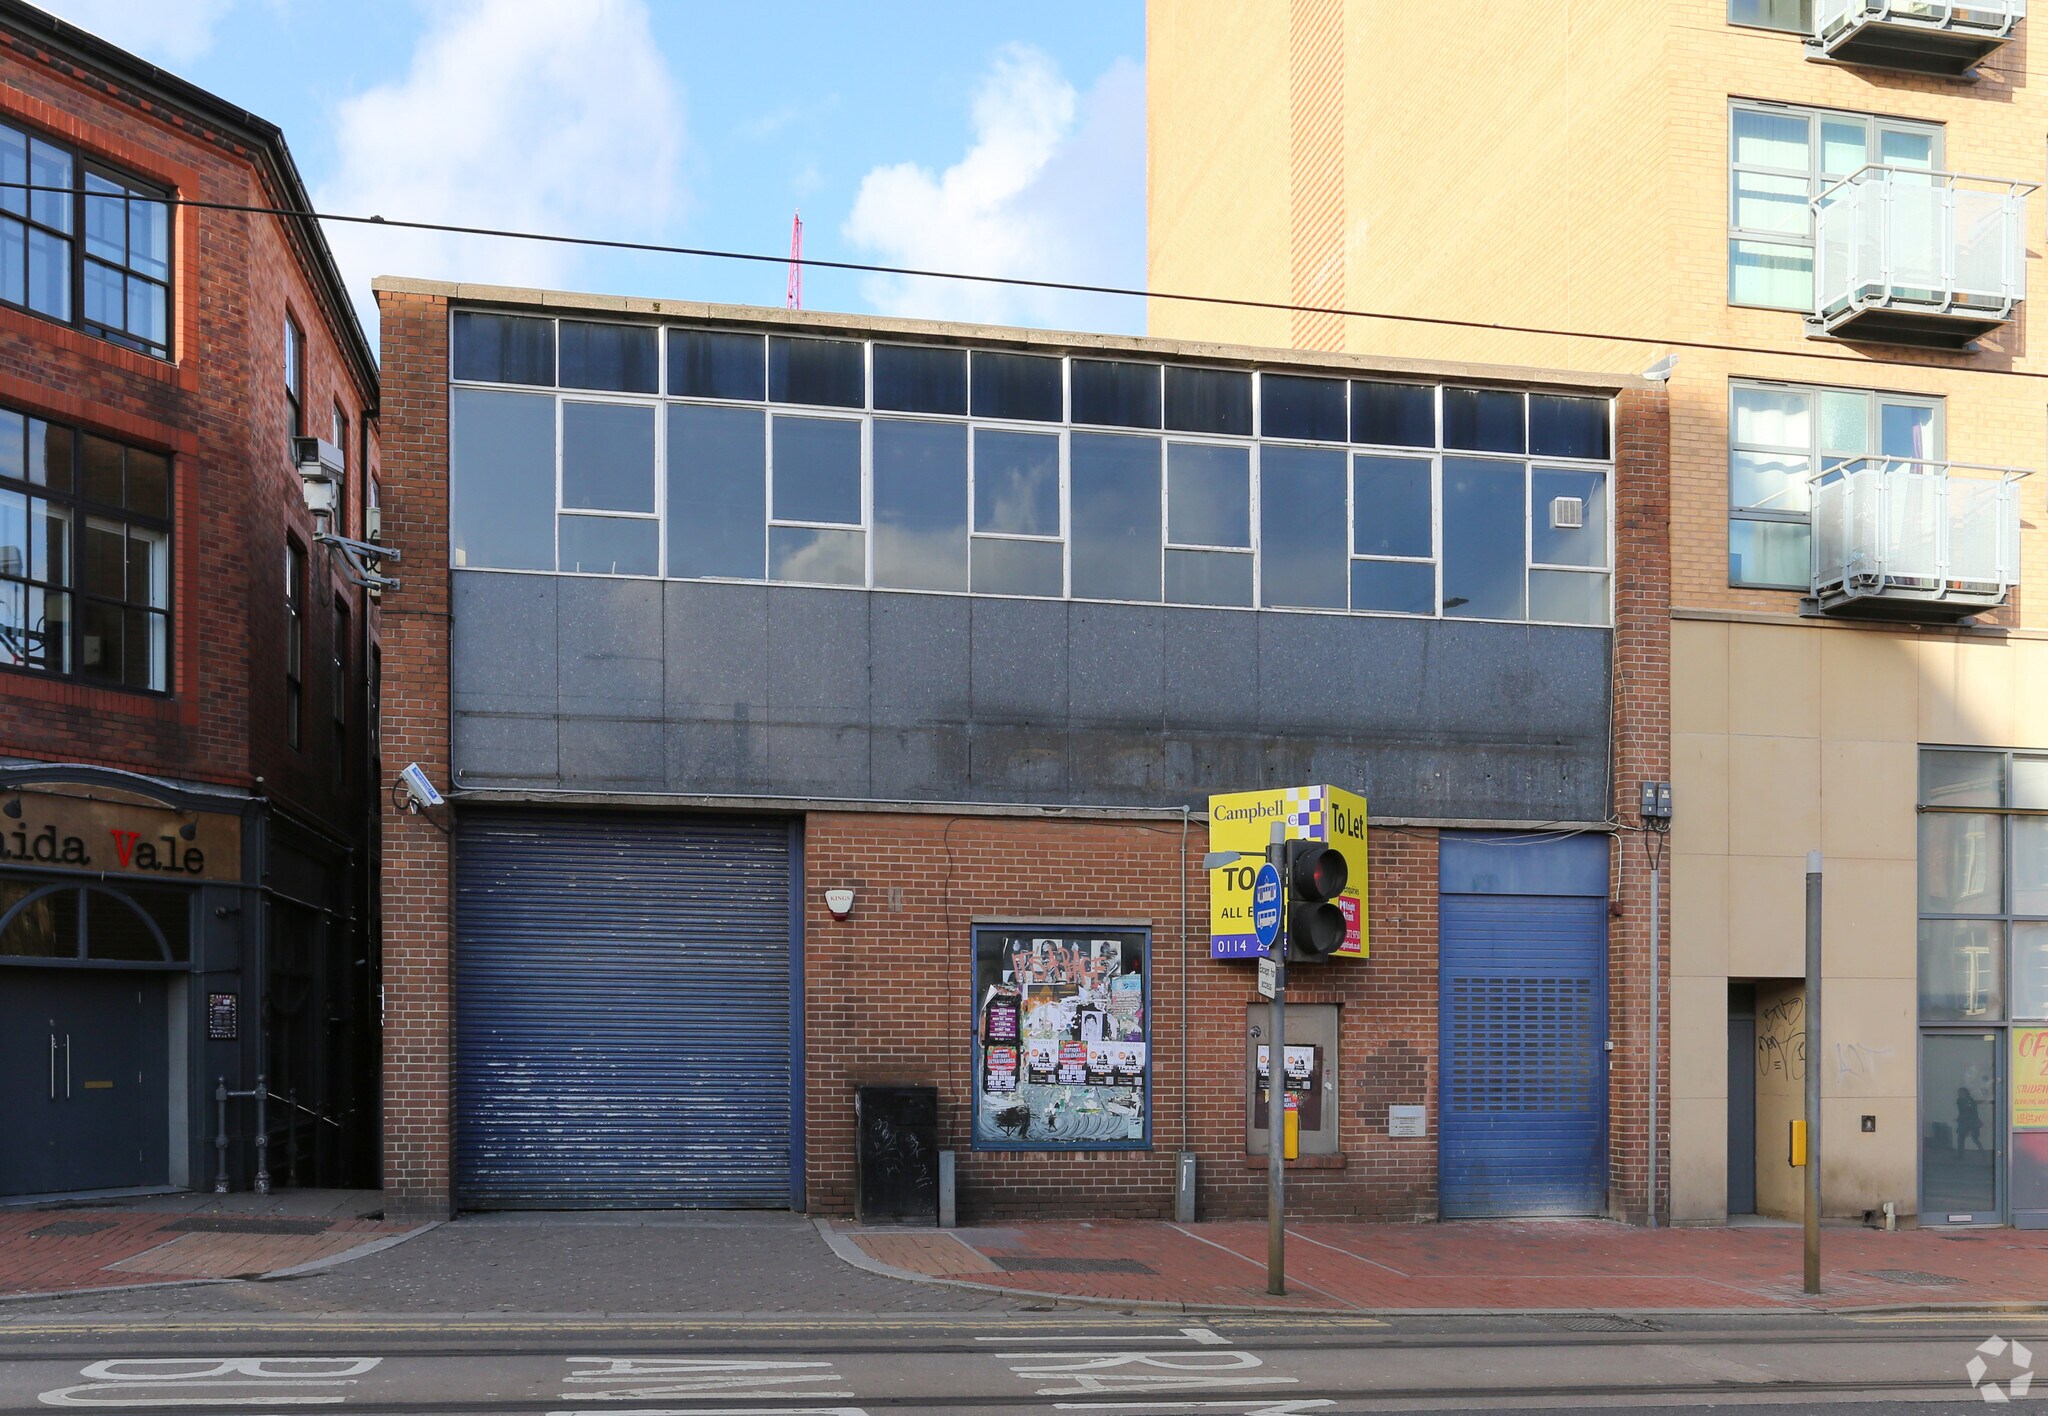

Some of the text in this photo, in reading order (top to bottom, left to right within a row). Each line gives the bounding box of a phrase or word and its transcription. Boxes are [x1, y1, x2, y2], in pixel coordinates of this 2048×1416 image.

[1213, 799, 1285, 824] Campbell
[1331, 803, 1364, 840] To Let
[110, 829, 205, 874] Vale
[1222, 866, 1256, 892] TO
[1221, 906, 1243, 919] ALL
[1217, 940, 1247, 953] 0114
